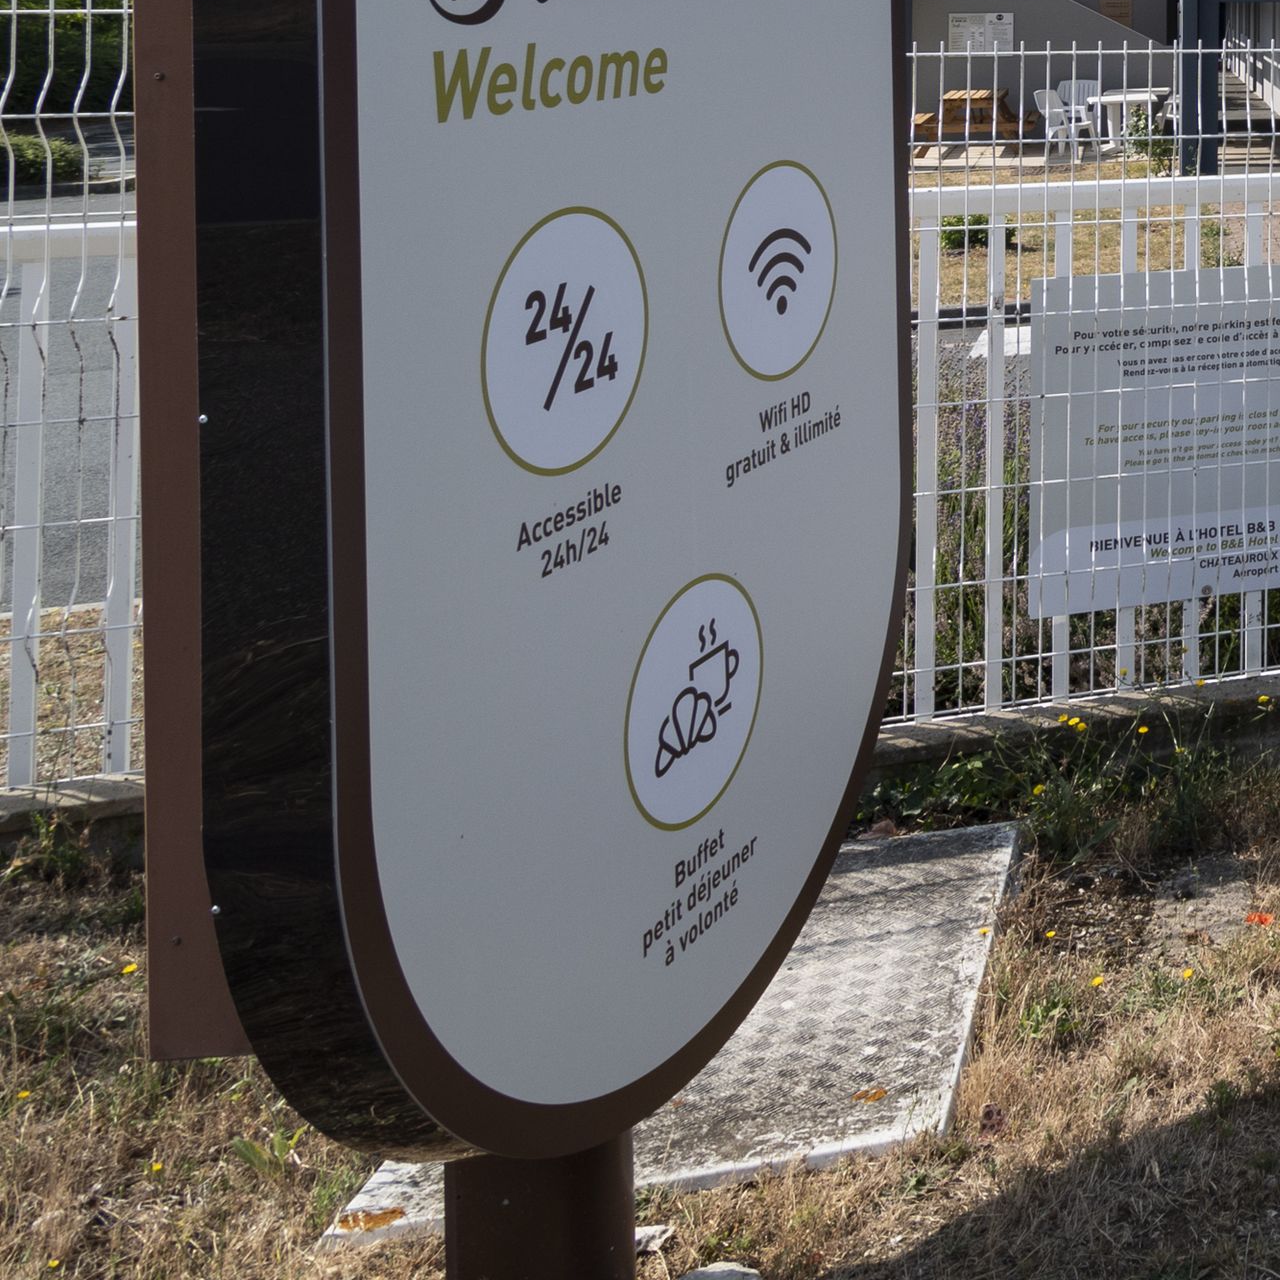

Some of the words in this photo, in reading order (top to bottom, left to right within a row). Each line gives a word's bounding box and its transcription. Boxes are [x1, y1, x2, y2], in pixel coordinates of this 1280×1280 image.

[432, 42, 669, 124] Welcome
[1055, 345, 1081, 355] Pour
[1083, 345, 1090, 355] y
[1194, 335, 1204, 344] e
[1272, 328, 1279, 339] à
[1073, 331, 1100, 340] Pou
[1102, 328, 1130, 338] votre
[1181, 323, 1209, 332] notre
[1254, 318, 1269, 327] est
[1140, 356, 1168, 365] navez
[1186, 352, 1215, 362] encore
[1180, 364, 1186, 372] à
[1187, 364, 1196, 372] la
[1197, 360, 1238, 371] réception
[759, 403, 788, 433] Wifi
[790, 391, 811, 417] HD
[1098, 424, 1116, 433] For
[1117, 422, 1139, 433] our
[1141, 417, 1180, 429] securty
[1182, 417, 1198, 426] ou
[726, 437, 777, 488] gratuit
[779, 432, 791, 455] &
[794, 404, 842, 450] illimité
[1097, 436, 1119, 445] have
[1183, 445, 1196, 454] go
[1187, 452, 1225, 461] atomatc
[516, 482, 623, 552] Accessible
[541, 521, 610, 579] 24h/24
[1089, 532, 1169, 553] BIENVENUE
[1175, 527, 1185, 543] À
[1247, 520, 1276, 534] B&B
[1150, 545, 1203, 558] Wecome
[1206, 542, 1217, 551] to
[1248, 533, 1279, 546] Hotel
[674, 828, 725, 888] Buffet
[643, 899, 683, 958] petit
[687, 836, 757, 913] déjeuner
[665, 938, 675, 967] à
[679, 880, 739, 952] volonté
